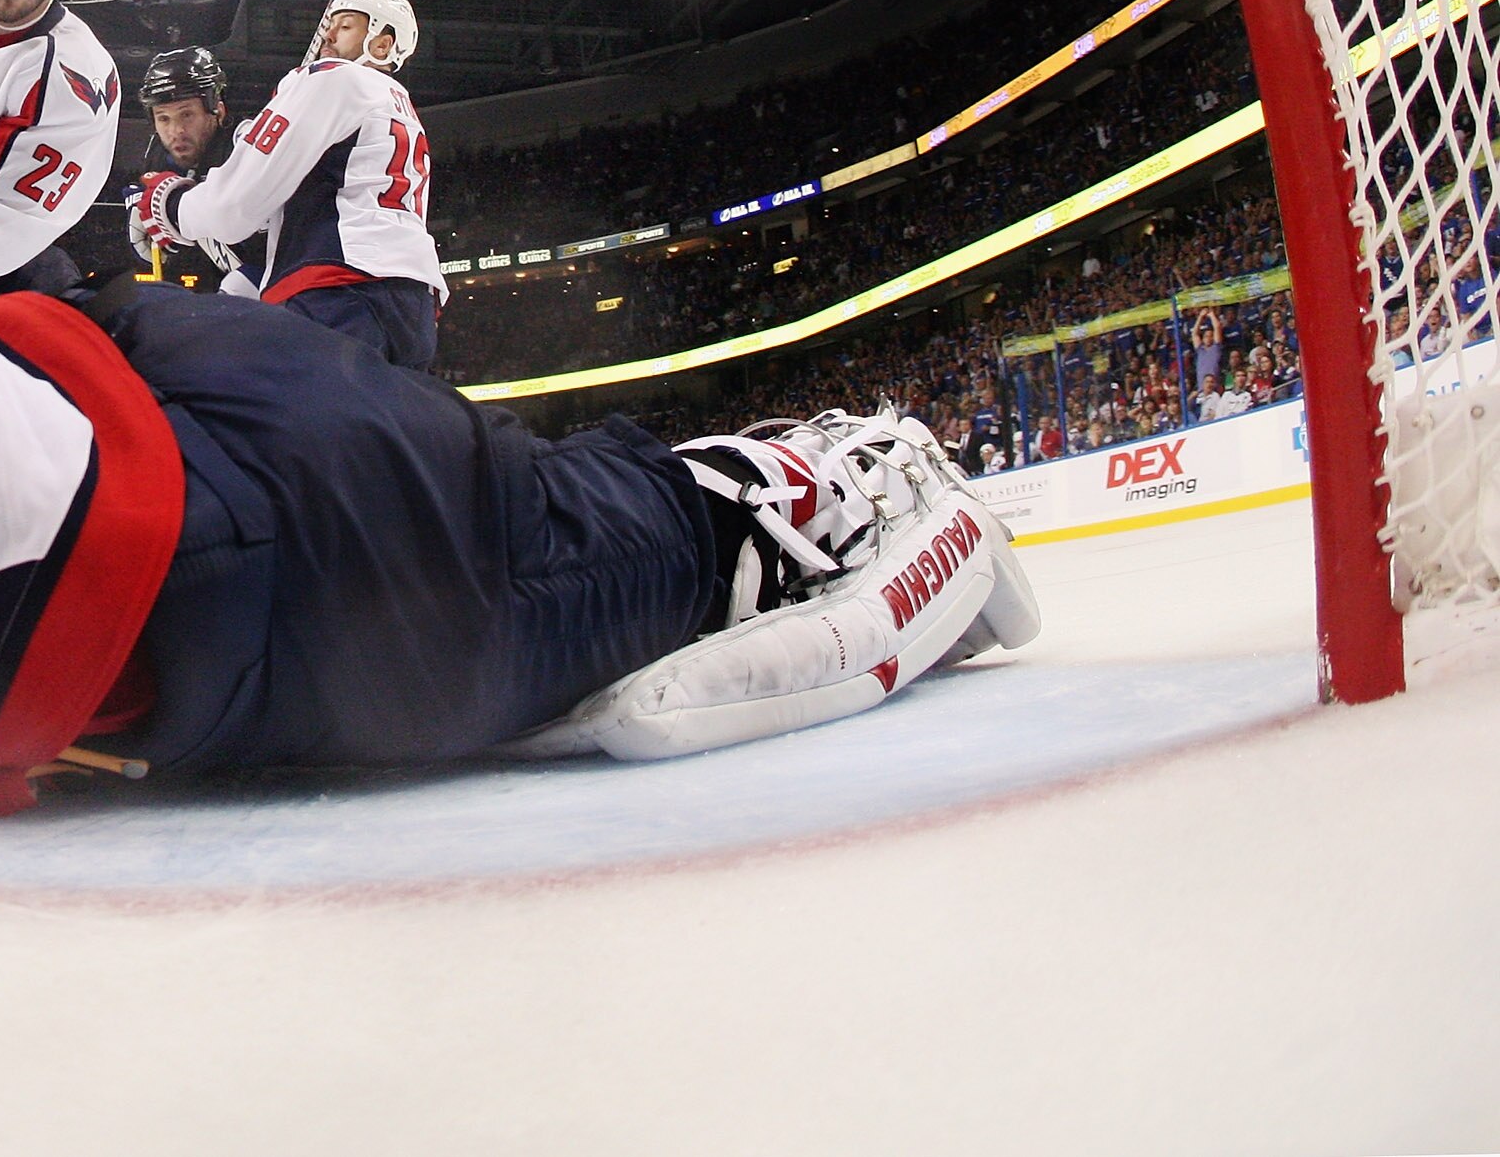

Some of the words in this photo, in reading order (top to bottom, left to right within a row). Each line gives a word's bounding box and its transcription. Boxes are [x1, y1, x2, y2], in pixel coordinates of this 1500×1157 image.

[243, 108, 290, 156] 18
[13, 143, 83, 212] 23
[1106, 438, 1187, 489] DEX
[1125, 477, 1198, 502] imaging
[880, 508, 982, 632] VAUGHN
